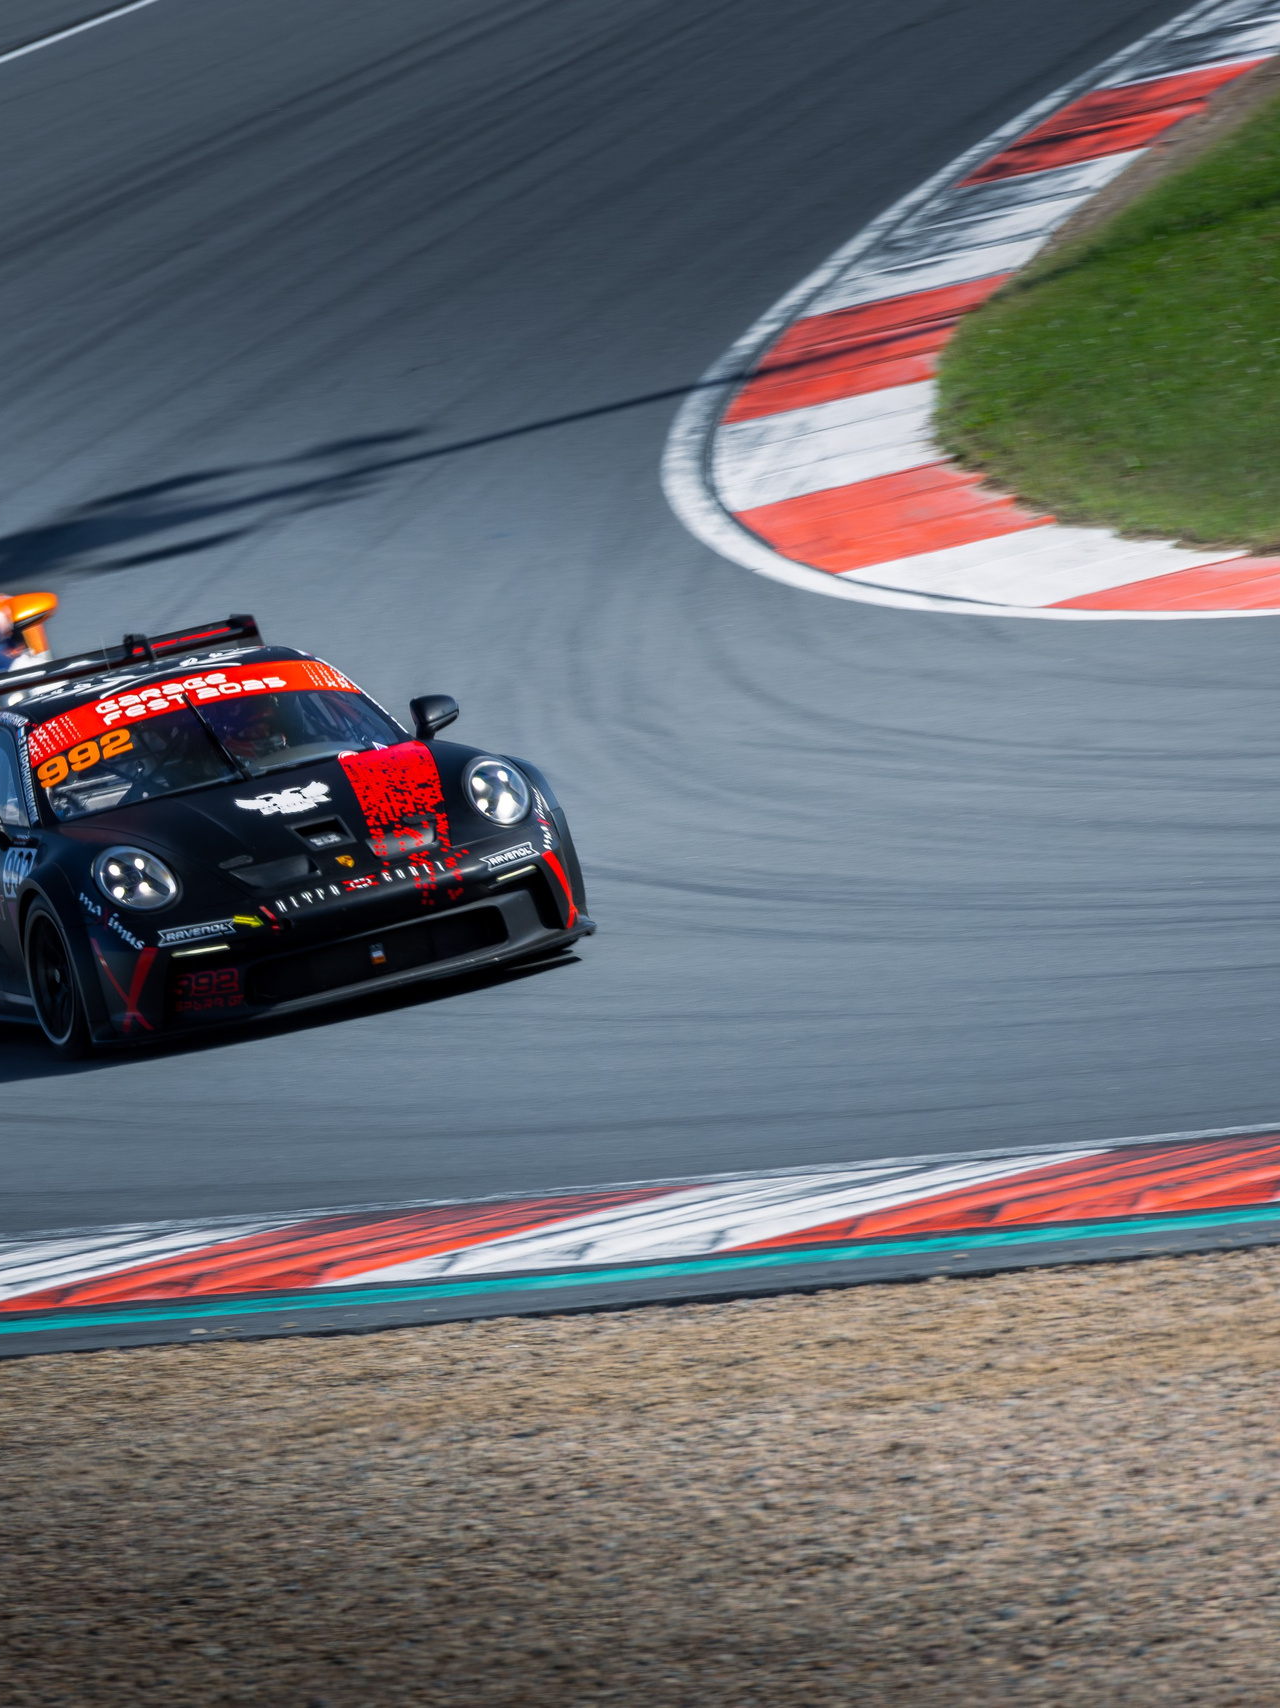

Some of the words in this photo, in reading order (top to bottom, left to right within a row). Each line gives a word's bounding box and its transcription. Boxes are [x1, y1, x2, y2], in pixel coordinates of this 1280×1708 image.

[196, 677, 287, 700] 2025
[37, 729, 133, 788] 992
[488, 846, 532, 866] RAVENOL
[166, 924, 228, 942] RAVENOL
